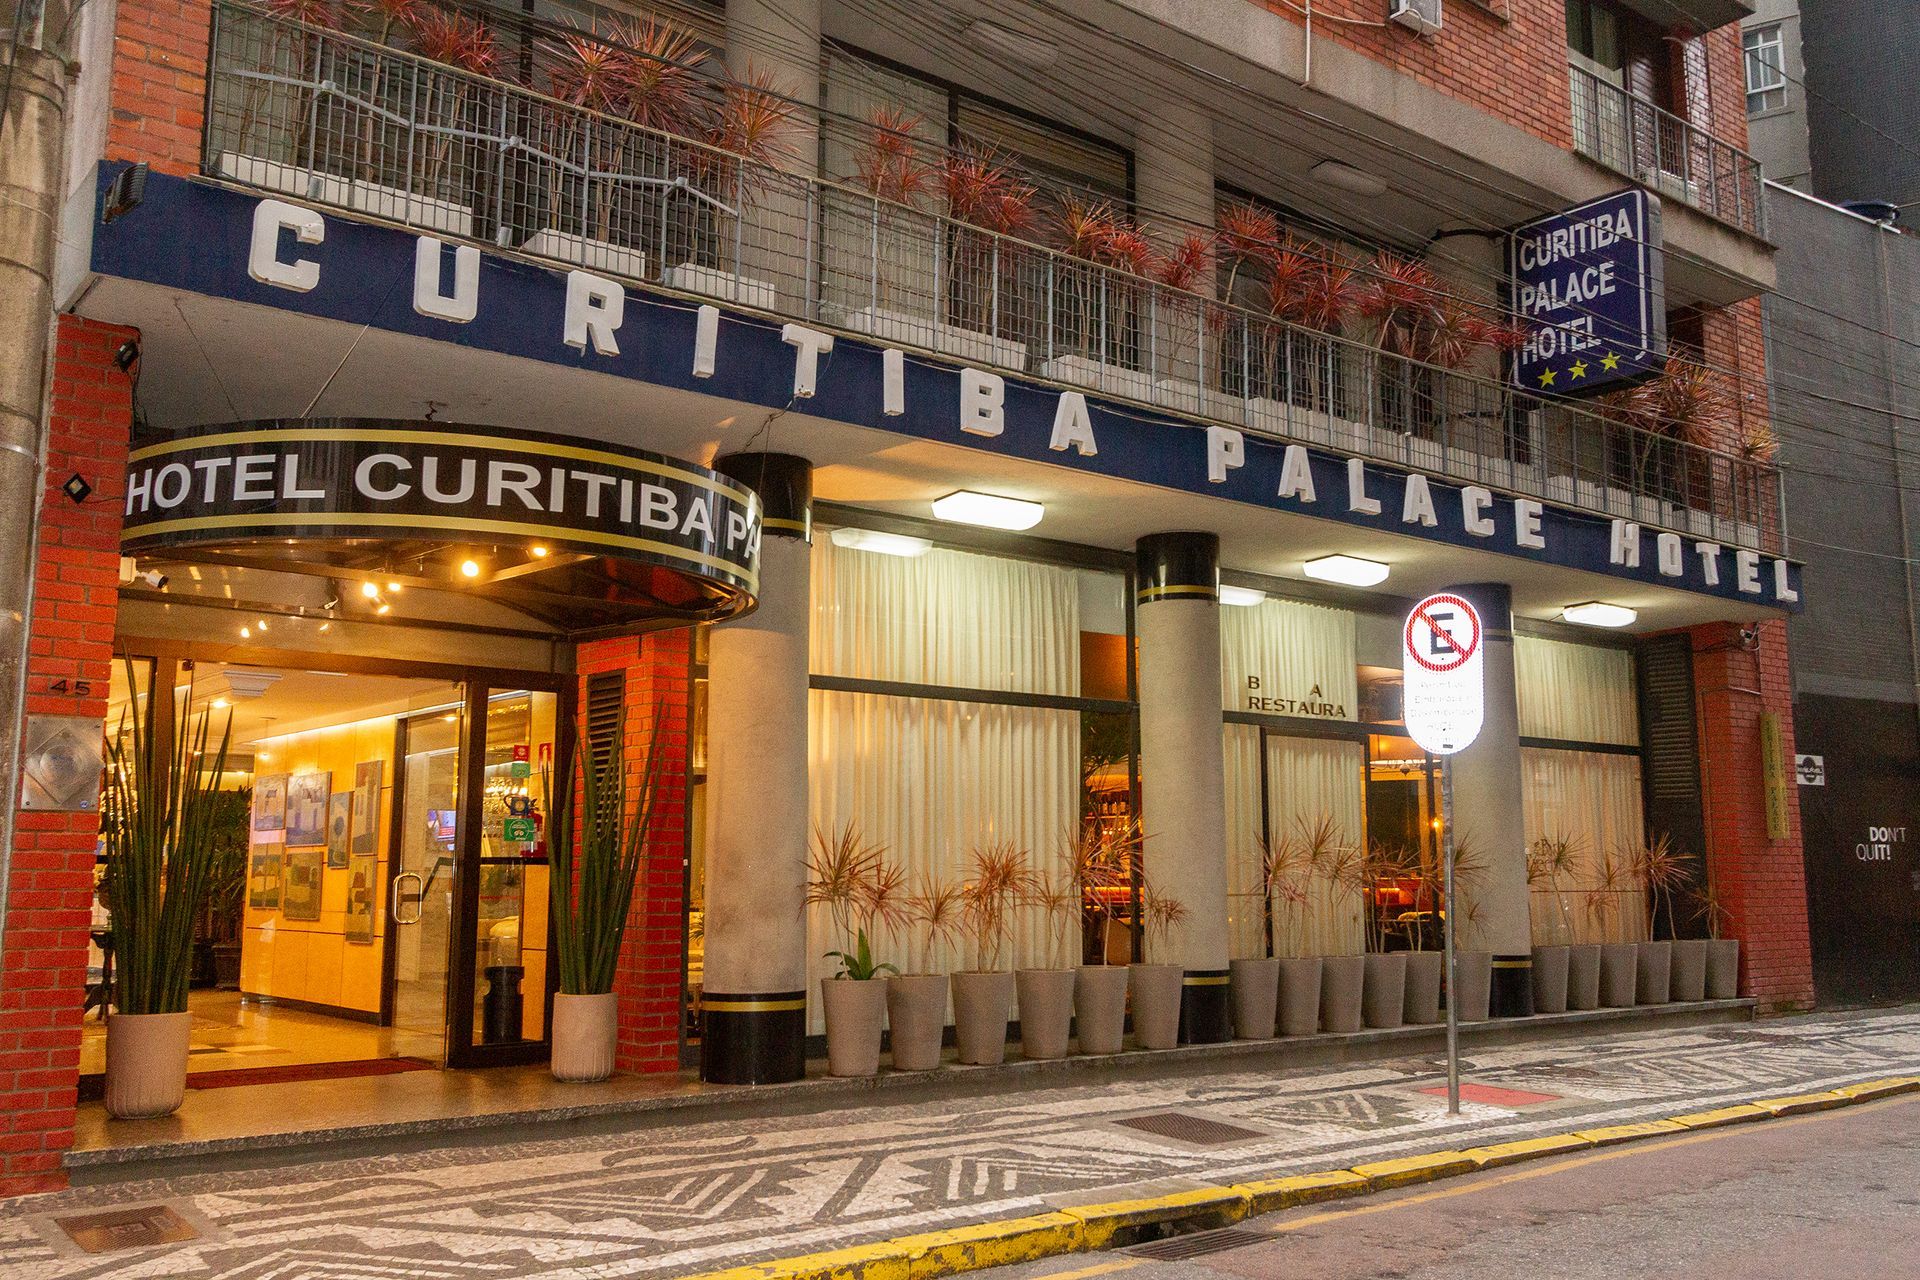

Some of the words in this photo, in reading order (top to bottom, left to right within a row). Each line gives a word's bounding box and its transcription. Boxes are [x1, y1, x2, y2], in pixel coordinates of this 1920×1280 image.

[1520, 208, 1633, 272] CURITIBA
[1521, 261, 1616, 315] PALACE
[1522, 316, 1602, 365] HOTEL
[248, 199, 1098, 457] CURITIBA
[1207, 425, 1545, 549] PALACE
[1610, 519, 1798, 602] HOTEL
[126, 453, 326, 516] HOTEL
[353, 453, 715, 543] CURITIBA
[1430, 612, 1455, 655] E
[50, 679, 91, 696] 45
[1248, 696, 1346, 718] RESTAURA
[1856, 844, 1891, 861] QUIT!
[1869, 826, 1906, 842] DON'T
